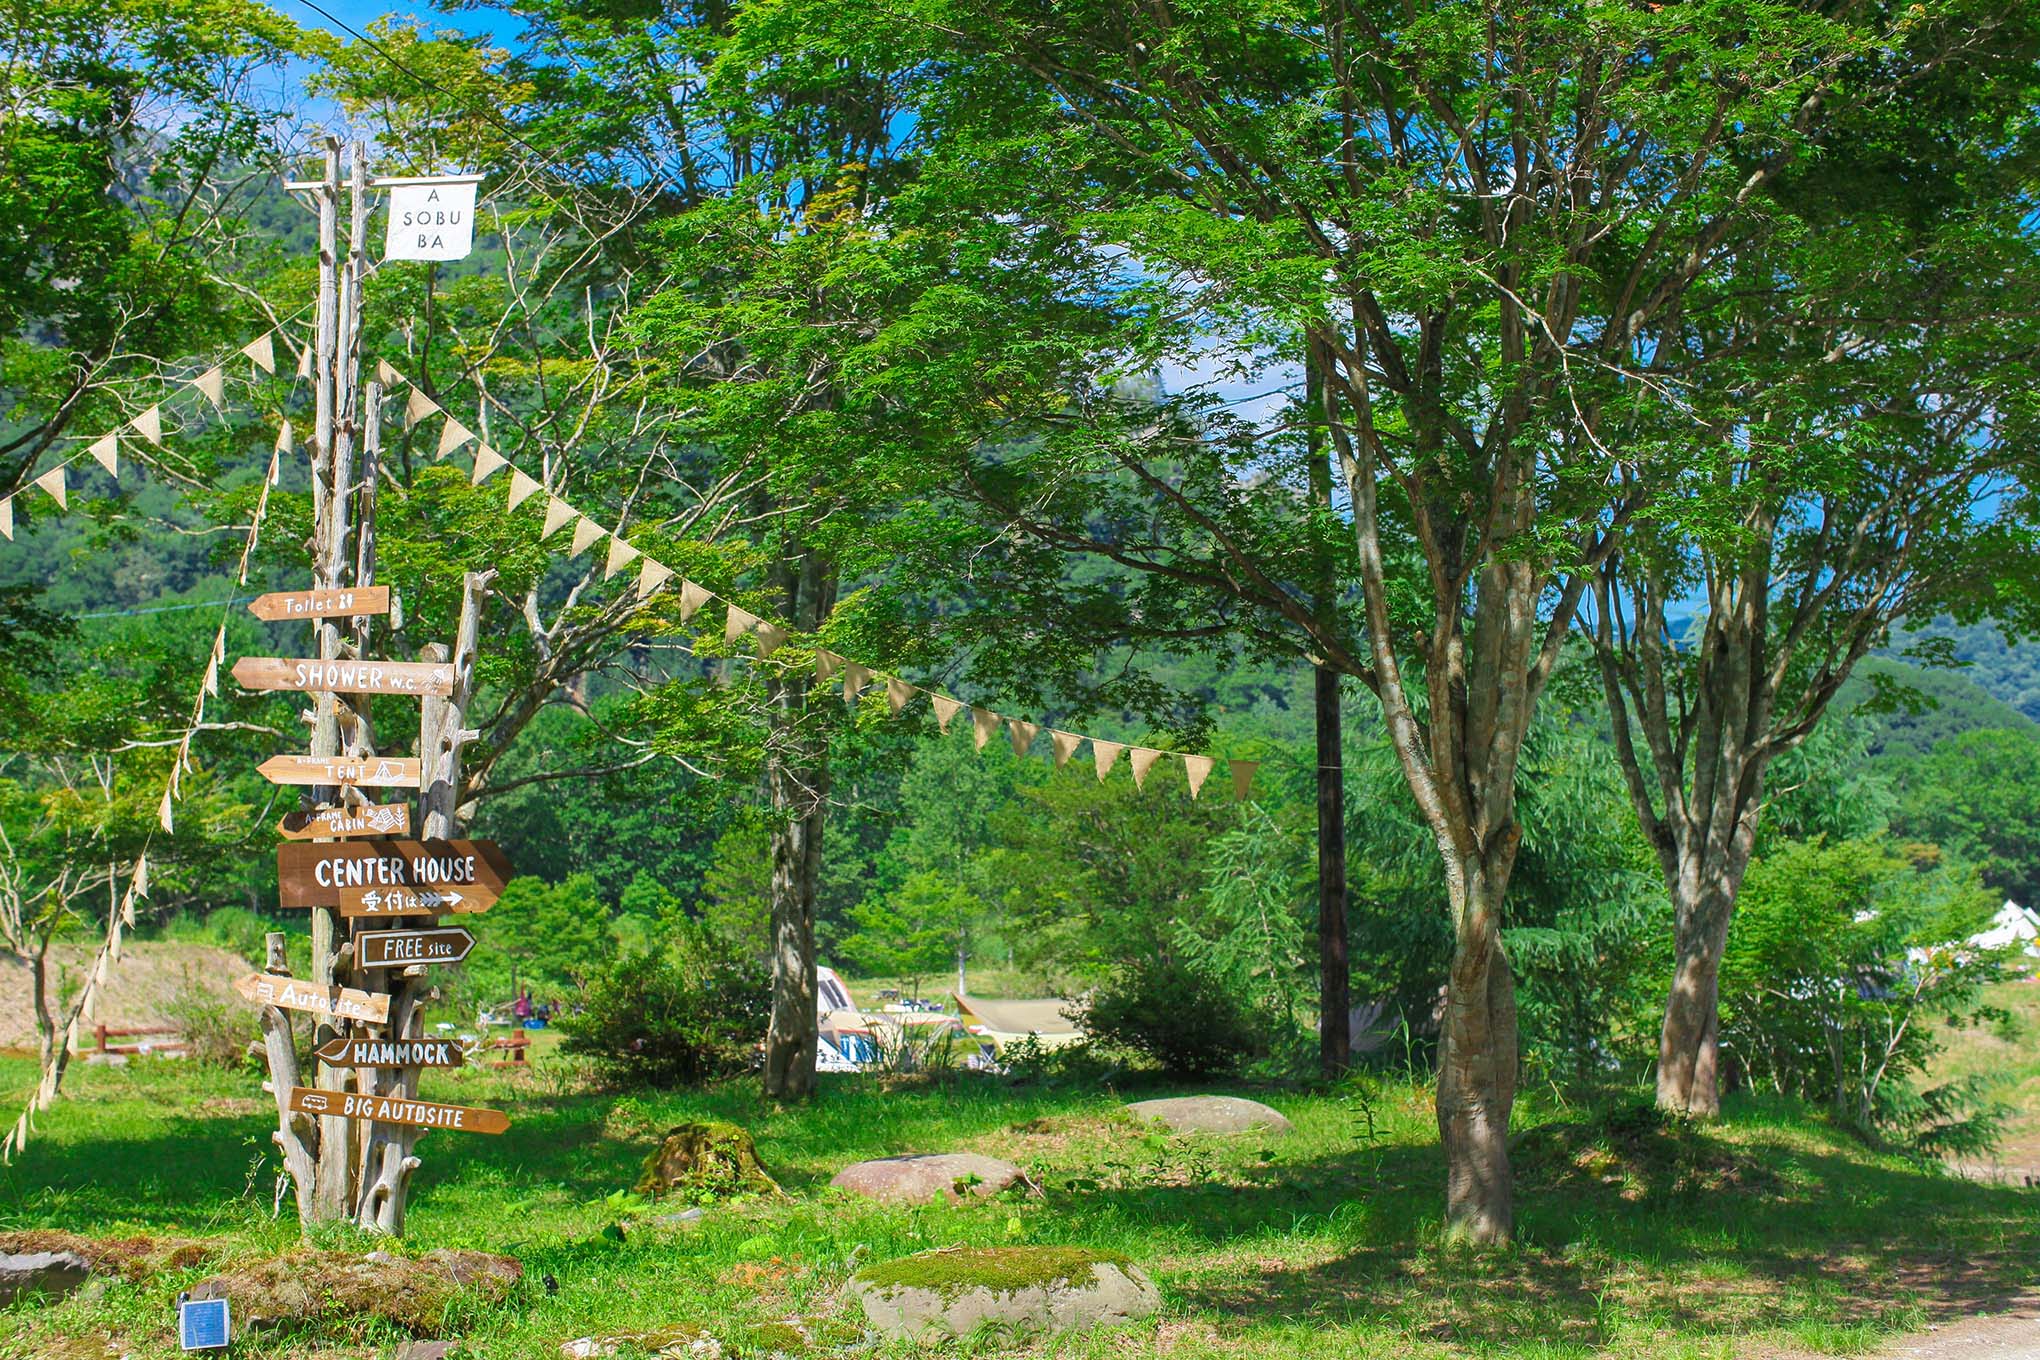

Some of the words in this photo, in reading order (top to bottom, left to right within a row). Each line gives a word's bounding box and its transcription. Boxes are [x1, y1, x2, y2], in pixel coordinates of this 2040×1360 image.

[427, 188, 440, 202] A
[403, 211, 461, 226] SOBU
[417, 234, 444, 249] BA
[285, 598, 332, 614] Toilet
[295, 663, 383, 689] SHOWER
[325, 765, 366, 781] TENT
[330, 819, 365, 833] CABIN
[315, 857, 406, 887] CENTER
[413, 856, 476, 882] HOUSE
[384, 938, 422, 960] FREE
[428, 940, 453, 956] site
[280, 983, 362, 1016] Autosite
[354, 1043, 450, 1065] HAMMOCK
[344, 1096, 373, 1117] BIG
[378, 1101, 464, 1128] AUTOSITE
